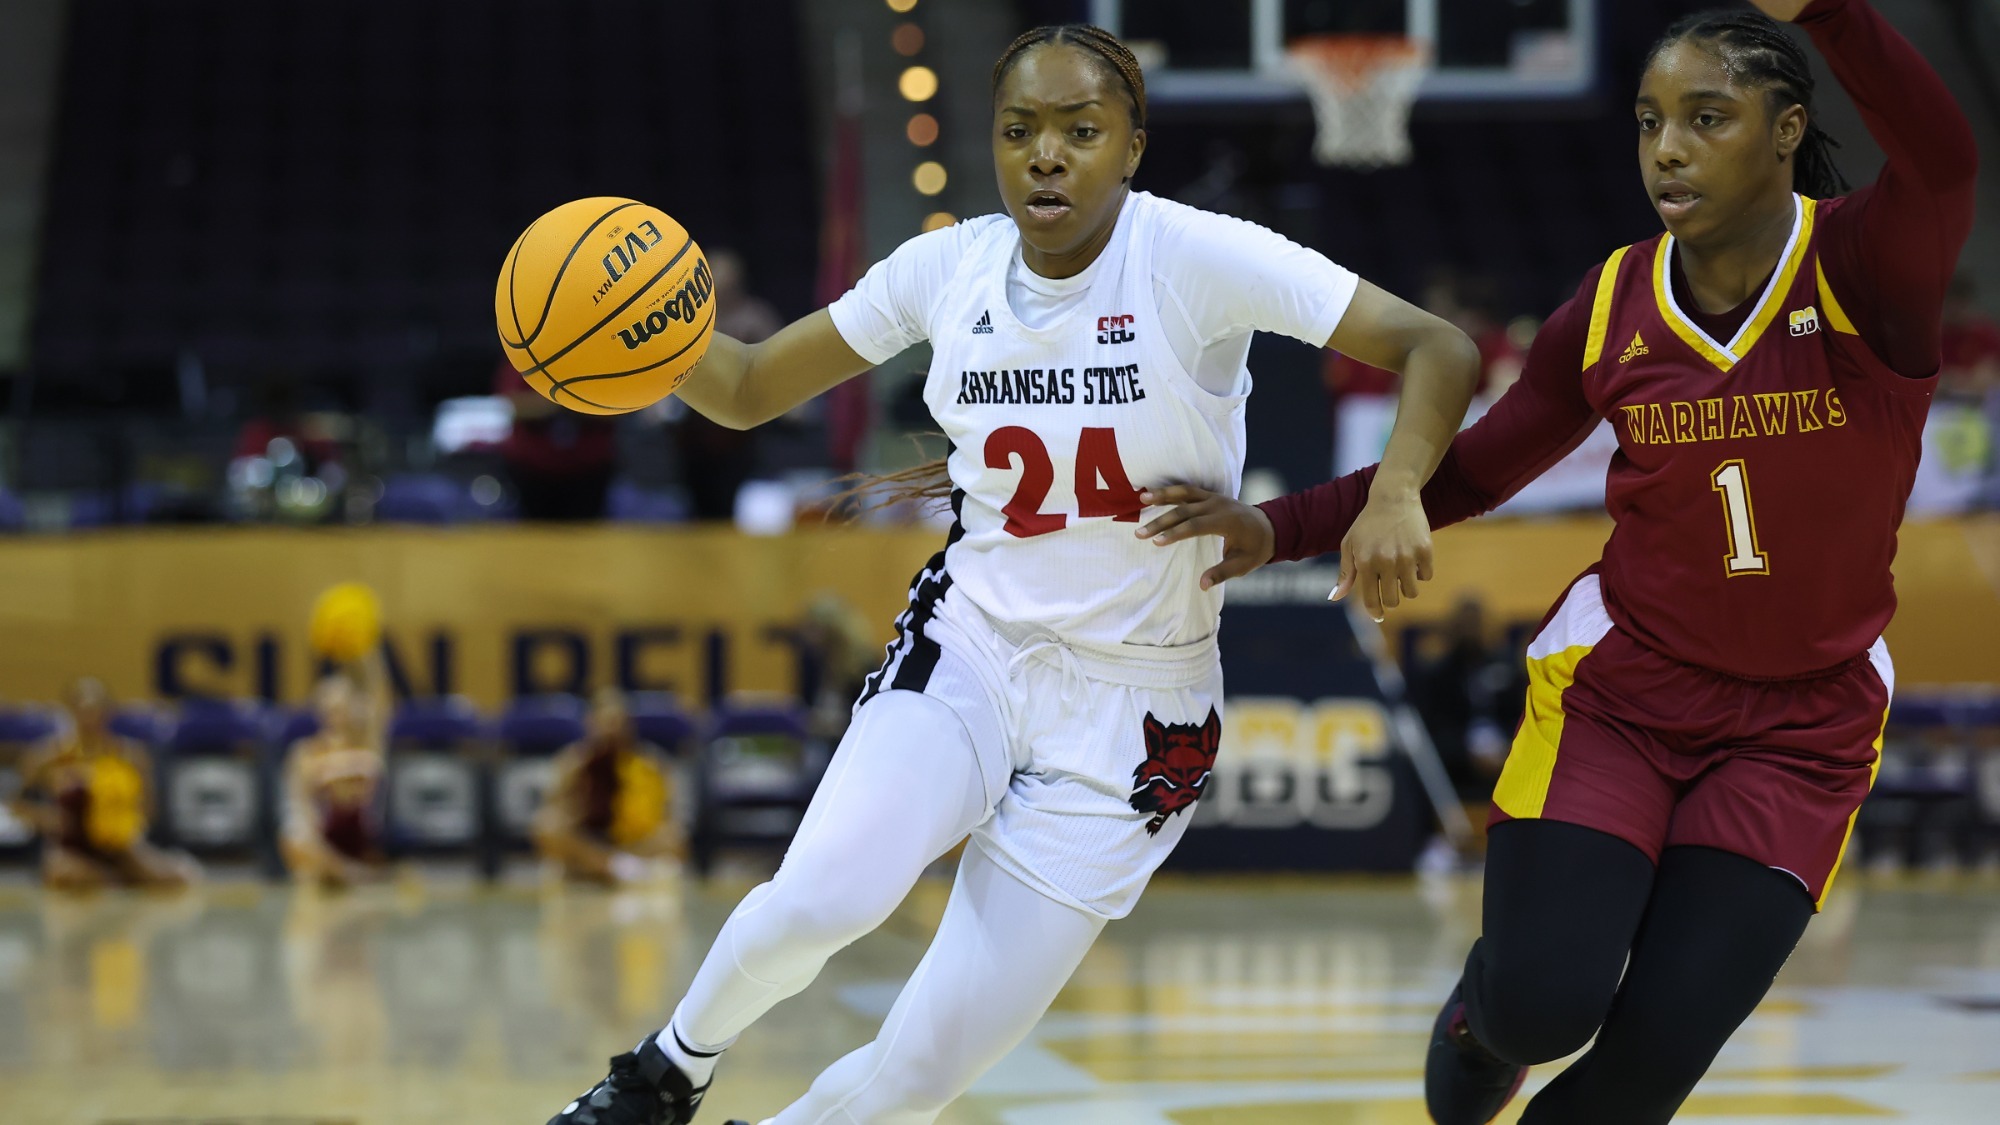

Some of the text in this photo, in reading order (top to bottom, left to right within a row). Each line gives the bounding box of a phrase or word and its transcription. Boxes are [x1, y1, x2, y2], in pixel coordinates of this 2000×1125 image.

[592, 279, 613, 307] NXT
[616, 256, 713, 350] Wilson
[645, 298, 661, 310] BALL
[661, 284, 676, 300] GAME
[972, 324, 994, 335] adidas
[1618, 344, 1649, 364] adidas
[956, 363, 1146, 405] ARKANSAS STATE
[1620, 387, 1847, 445] WARHAWKS
[983, 425, 1152, 539] 24
[1710, 458, 1770, 579] 1
[1194, 697, 1393, 830] BC
